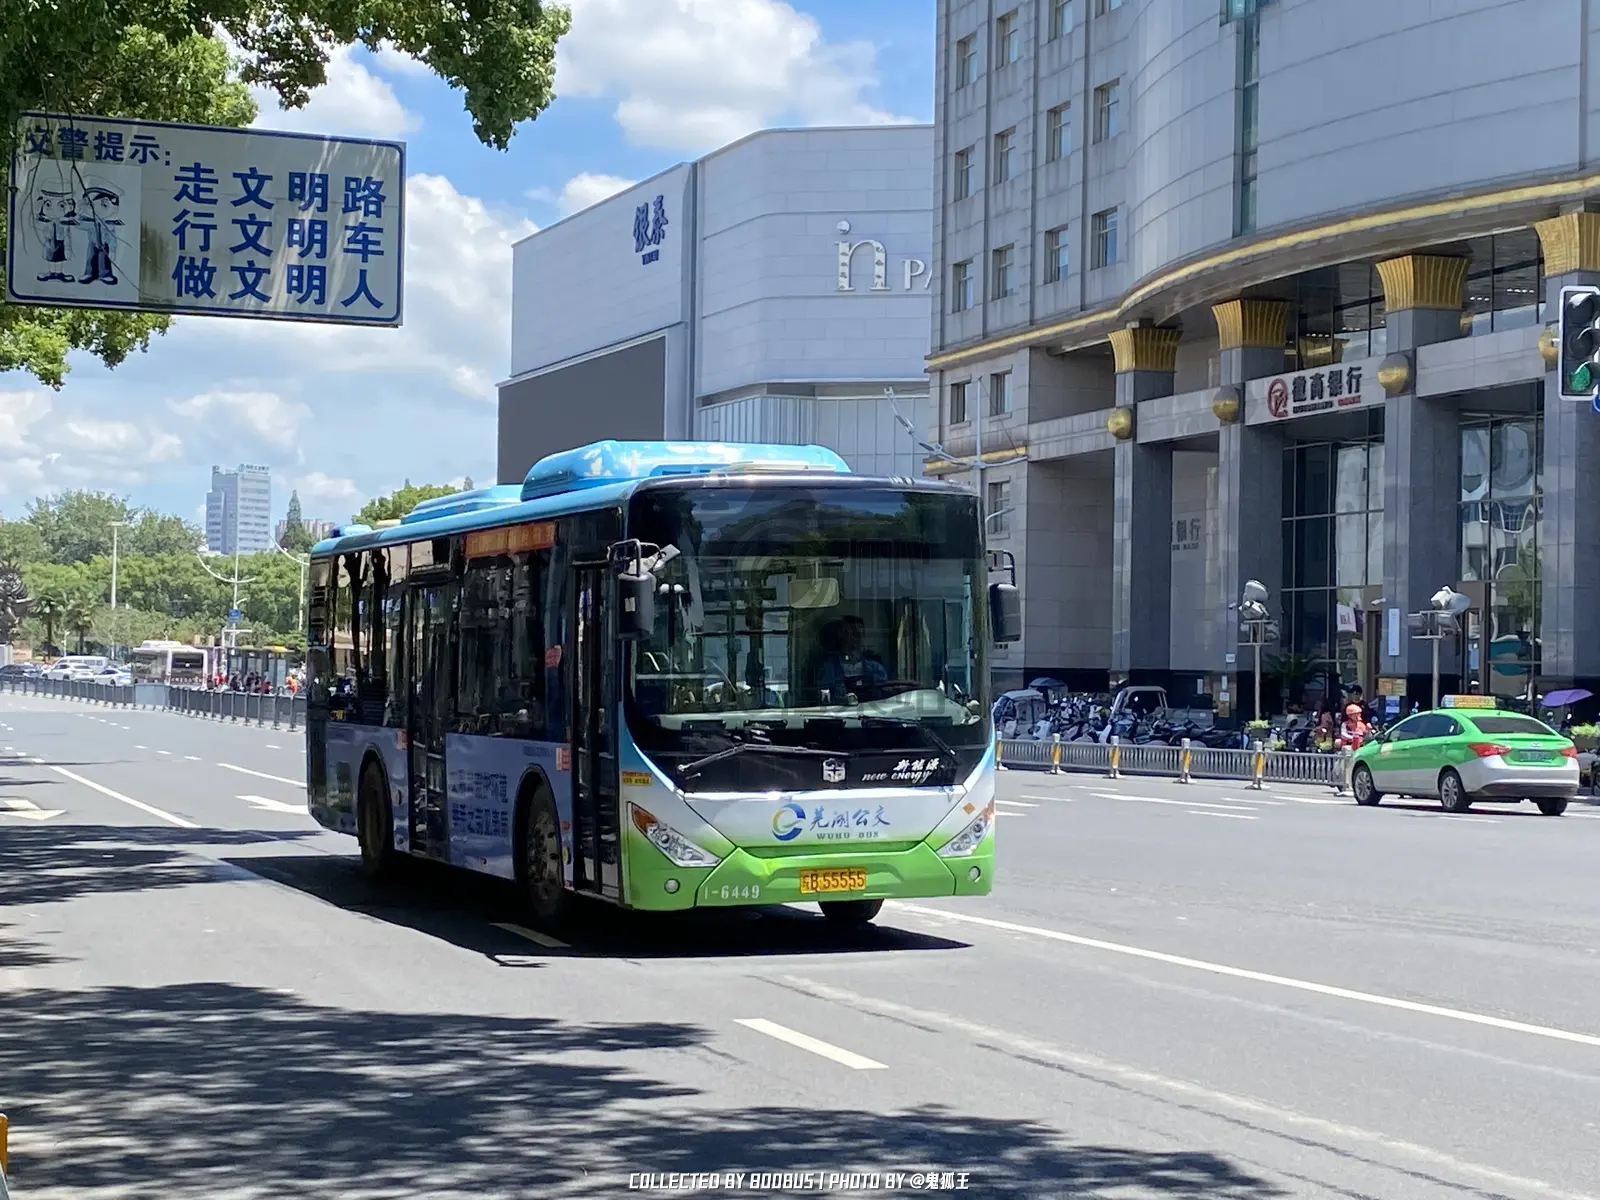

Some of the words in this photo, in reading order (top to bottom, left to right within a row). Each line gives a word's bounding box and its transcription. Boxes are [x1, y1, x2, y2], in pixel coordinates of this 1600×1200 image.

[173, 163, 386, 219] 走文明路
[172, 209, 385, 263] 行文明车
[834, 220, 891, 291] in
[171, 256, 384, 310] 做文明人
[861, 772, 889, 781] new
[891, 770, 932, 783] energy
[810, 805, 891, 831] 芜湖公交
